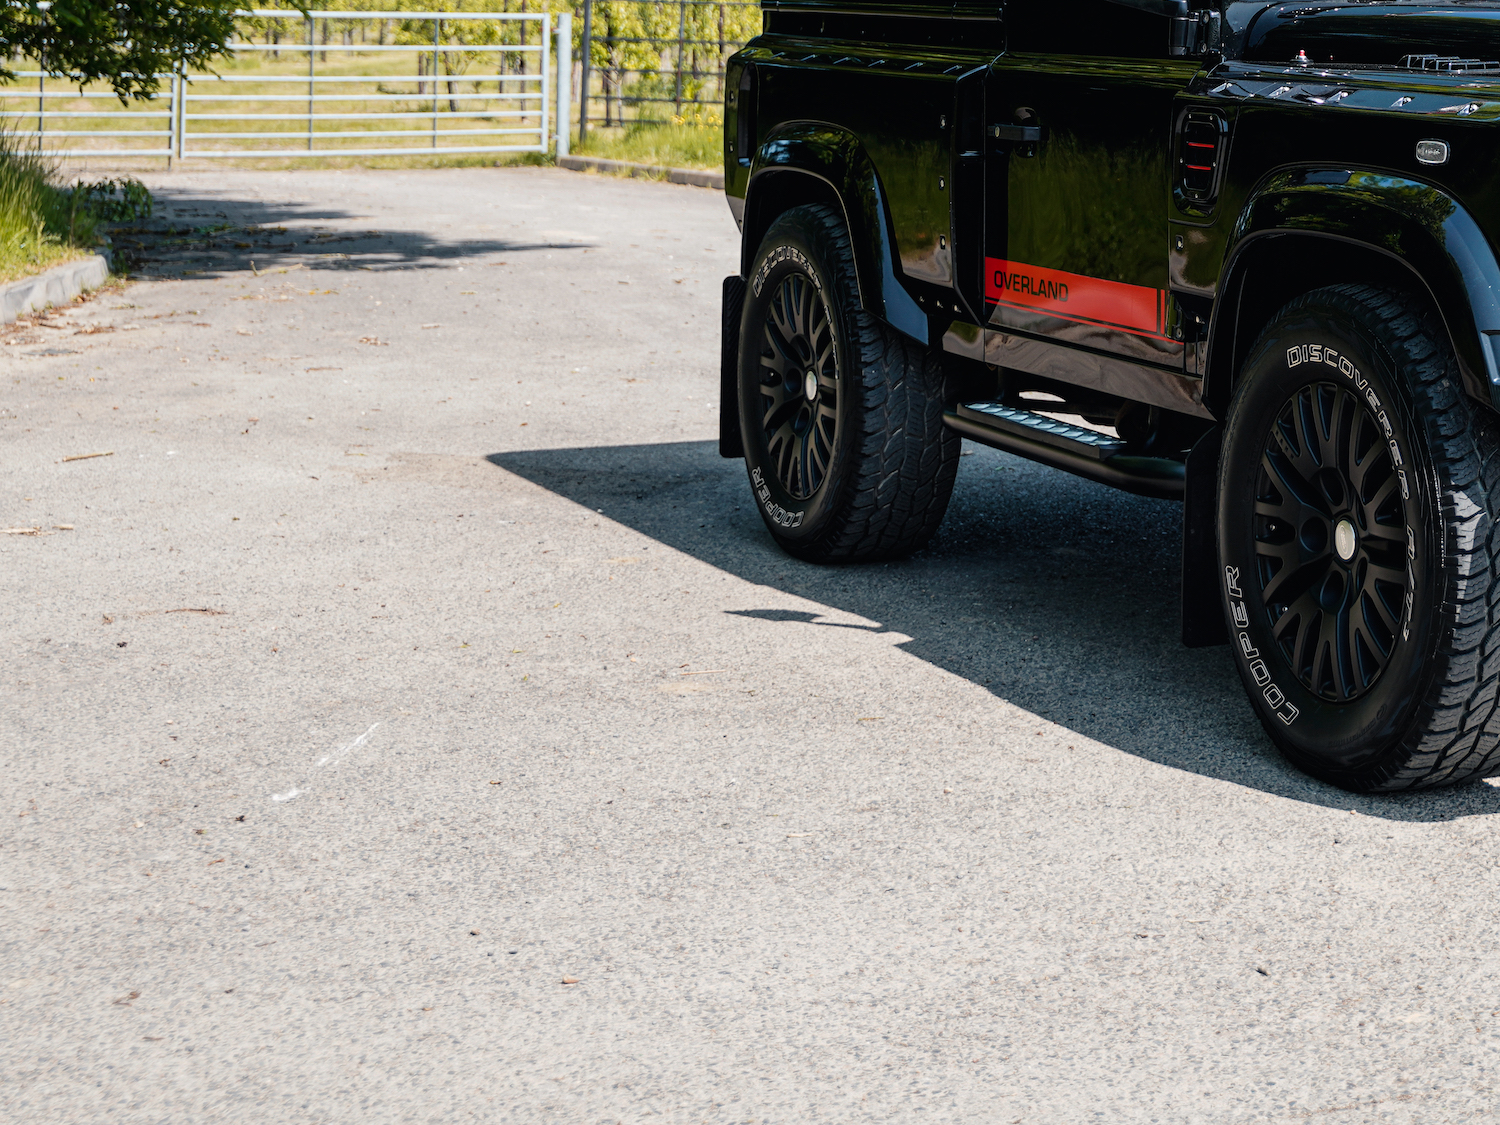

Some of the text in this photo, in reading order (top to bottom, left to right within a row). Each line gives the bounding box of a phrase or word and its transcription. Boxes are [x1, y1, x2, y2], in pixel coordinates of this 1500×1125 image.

[994, 270, 1069, 302] OVERLAND
[1286, 344, 1410, 500] DISCOVERER
[752, 466, 804, 528] COOPER
[1225, 565, 1299, 725] COOPER
